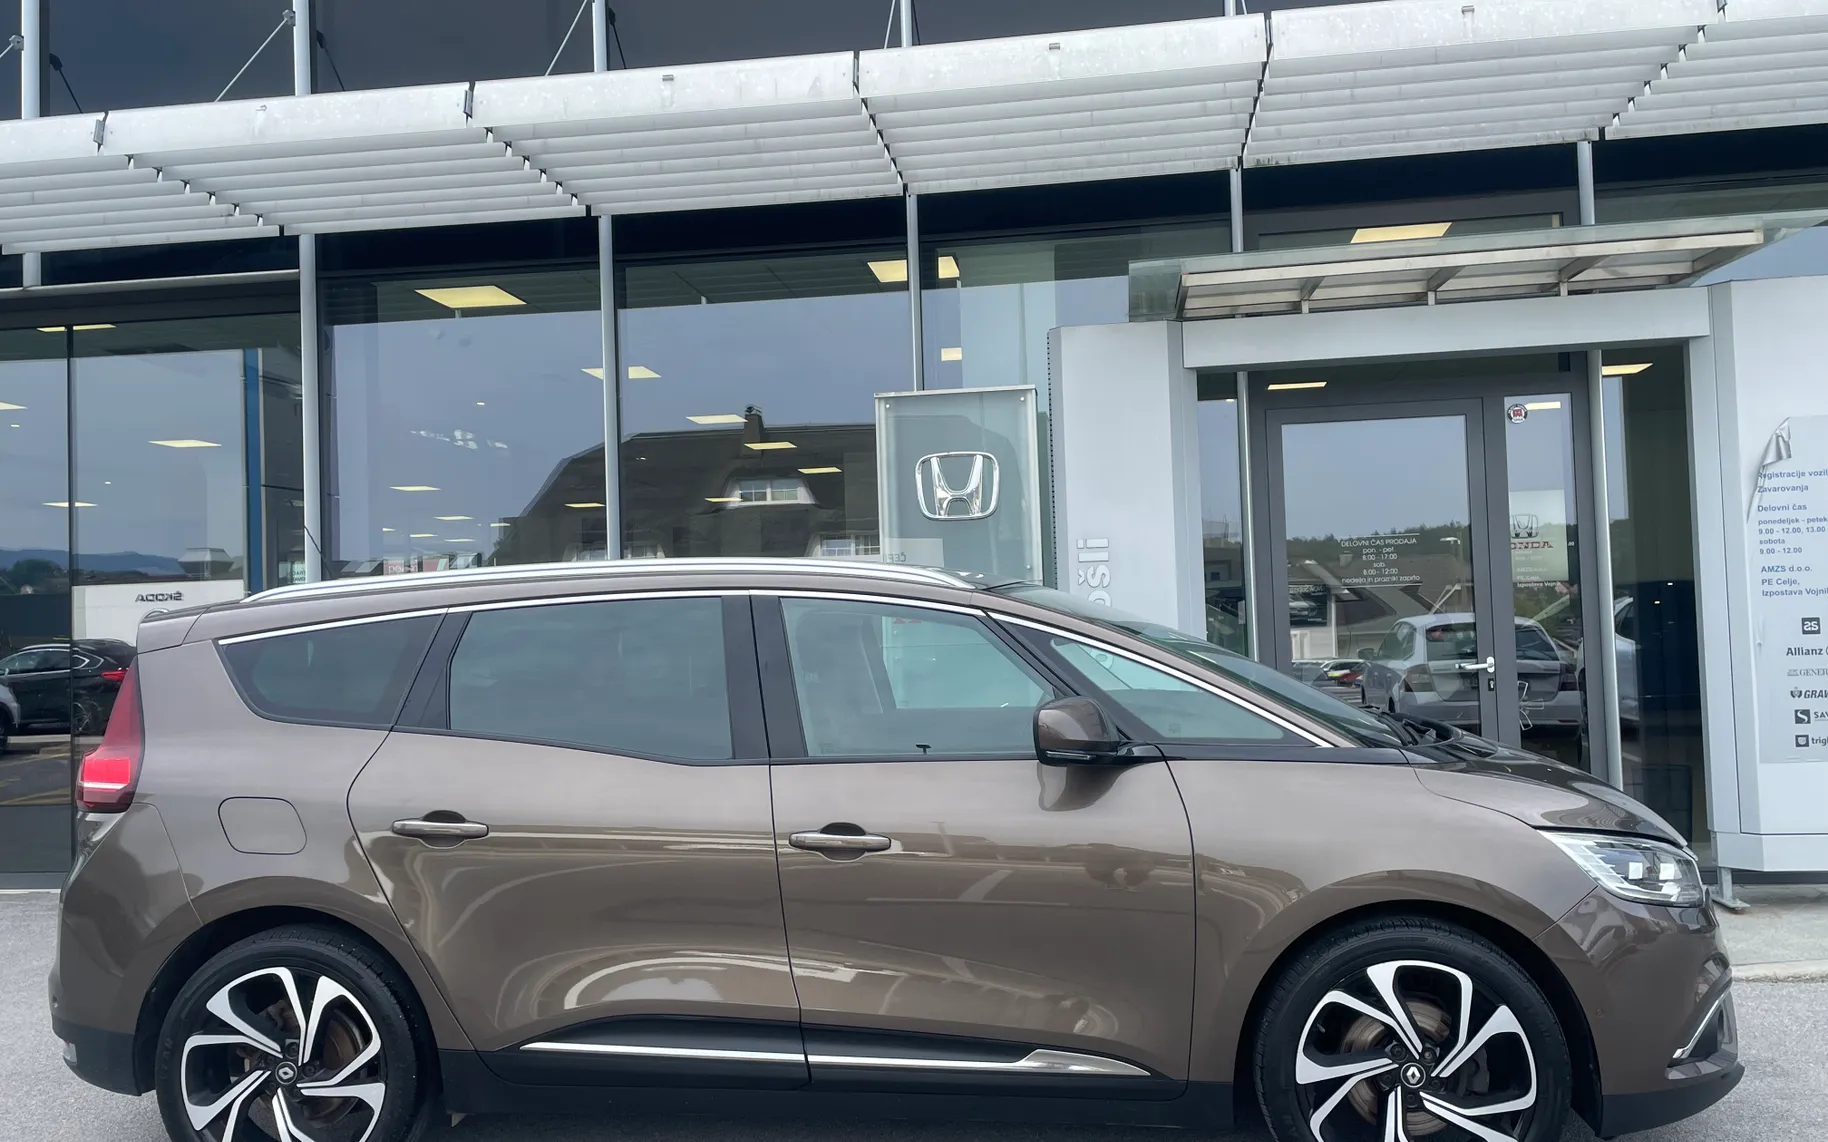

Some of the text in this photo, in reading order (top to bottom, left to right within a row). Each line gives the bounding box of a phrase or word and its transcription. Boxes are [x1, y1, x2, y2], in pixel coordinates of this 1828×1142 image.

[1758, 470, 1806, 480] Registracije
[1758, 484, 1809, 493] Zavarovanja
[1758, 503, 1807, 512] Delovni čas
[1758, 517, 1799, 526] ponedeljek
[1806, 516, 1828, 524] petek
[1370, 538, 1384, 546] ČAS
[1386, 537, 1417, 545] PRODAJA
[1511, 541, 1554, 550] ONDA
[1761, 565, 1786, 573] AMZS
[1776, 578, 1800, 587] Celje,
[1762, 589, 1803, 598] Izpostava
[1786, 647, 1824, 656] Allianz
